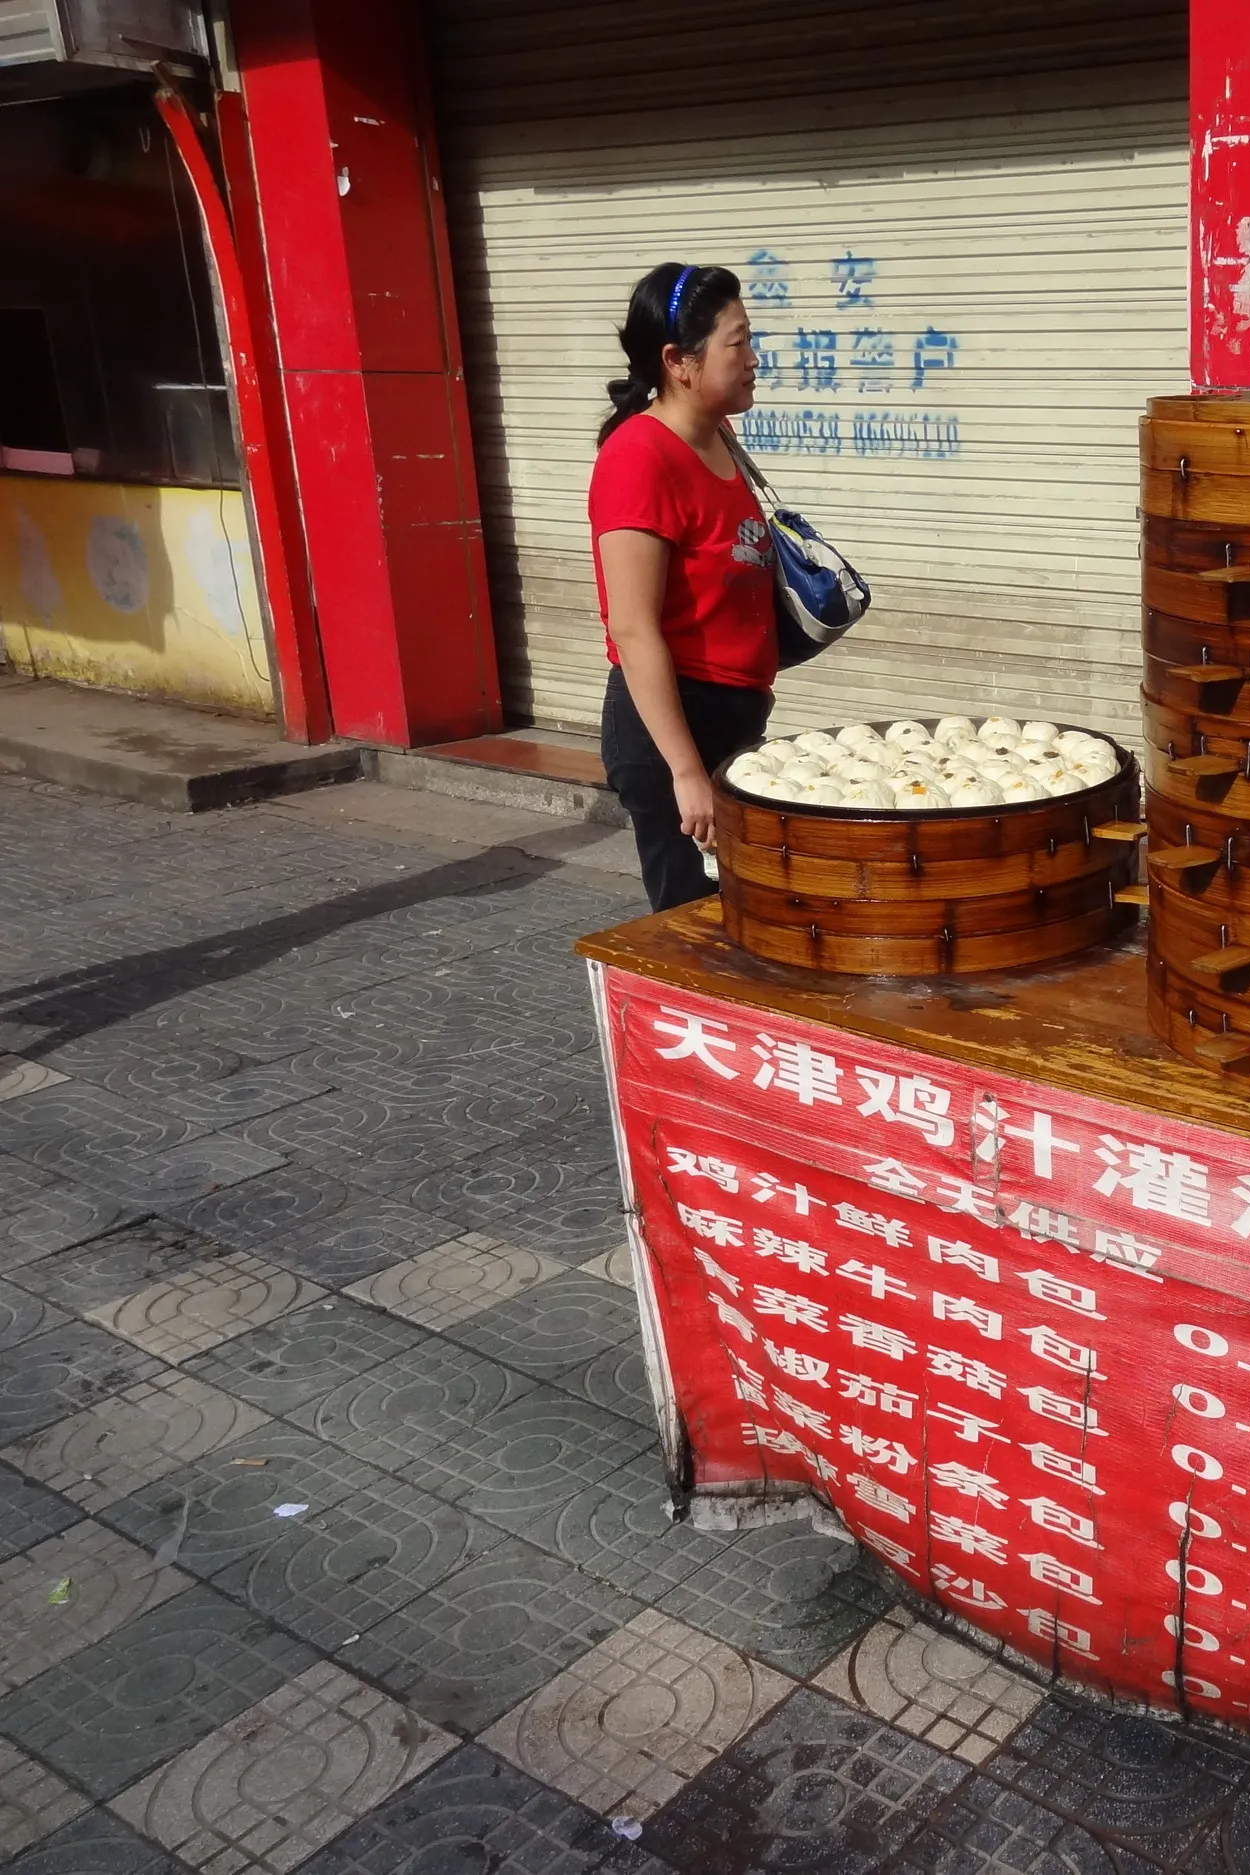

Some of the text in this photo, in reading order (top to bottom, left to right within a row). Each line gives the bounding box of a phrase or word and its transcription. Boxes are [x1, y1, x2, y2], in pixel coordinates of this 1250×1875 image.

[665, 1146, 1108, 1321] 鸡汁鲜肉包
[677, 1202, 1108, 1381] 麻辣牛肉包
[862, 1157, 1164, 1284] 全天供应
[708, 1291, 1107, 1496] 青椒茄子包
